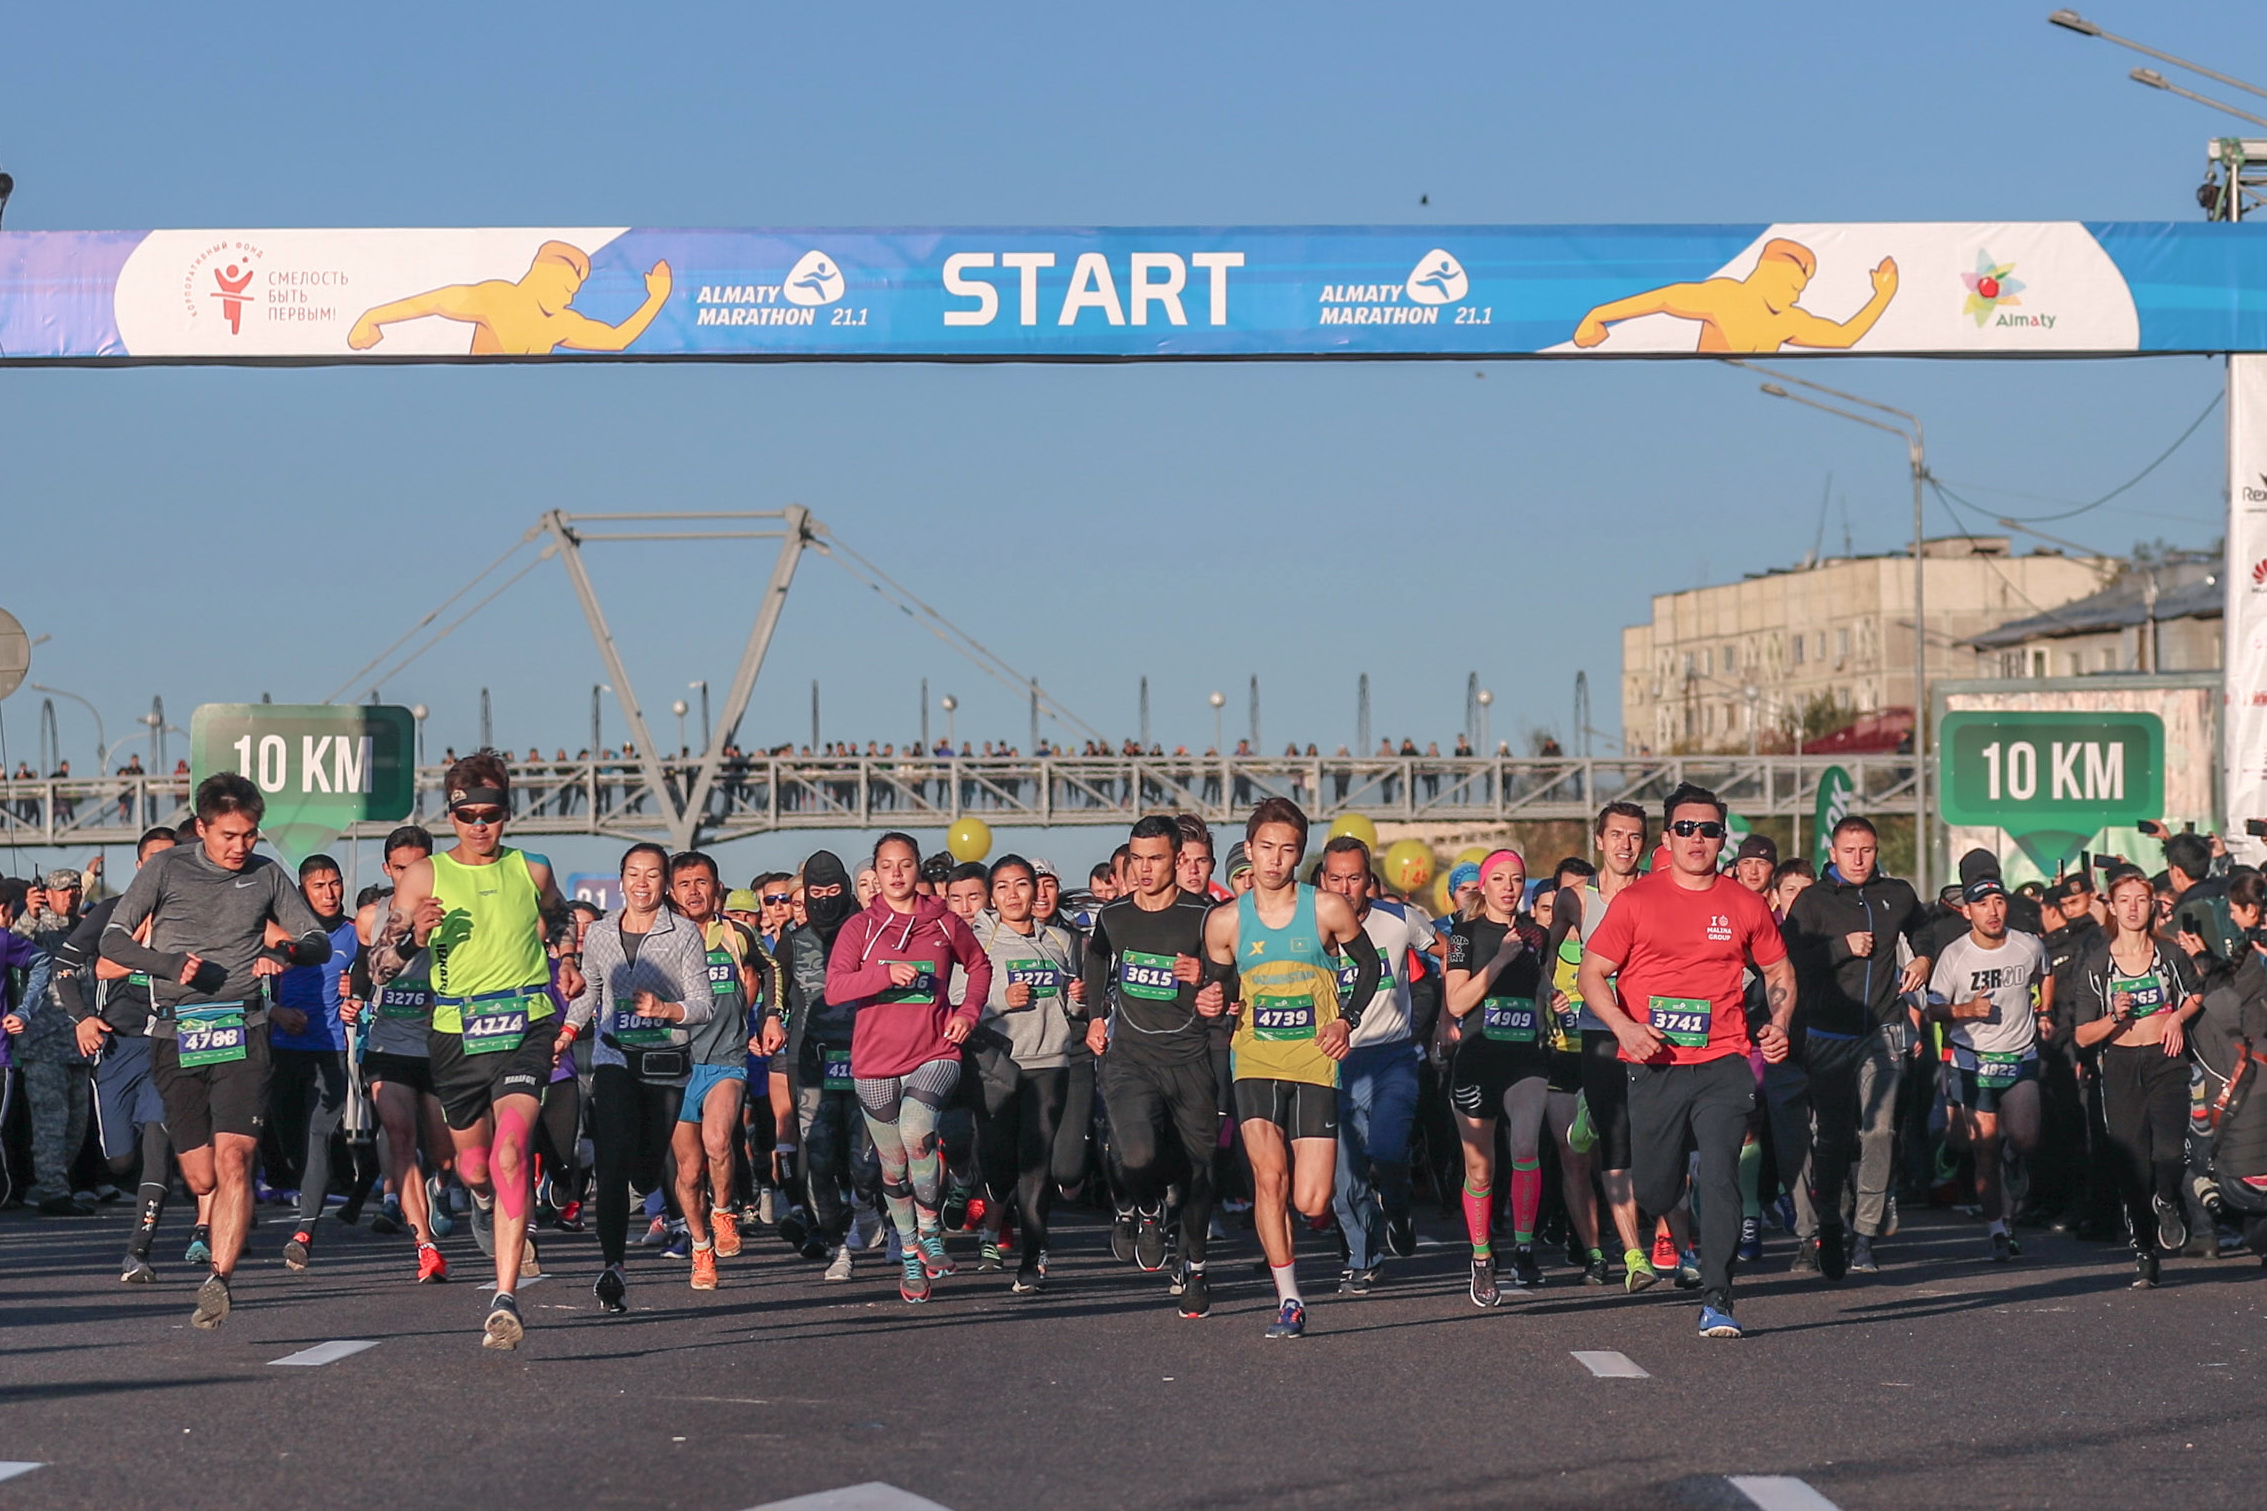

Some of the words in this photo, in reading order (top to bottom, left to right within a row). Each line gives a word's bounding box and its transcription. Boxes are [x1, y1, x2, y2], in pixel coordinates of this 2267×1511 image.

[235, 241, 264, 259] ФОНД
[268, 271, 349, 285] СМЕЛОСТЬ
[268, 289, 308, 303] БЫТЬ
[696, 286, 781, 304] ALMATY
[942, 252, 1245, 326] START
[1319, 285, 1404, 302] ALMATY
[268, 307, 336, 321] ПЕРВЫМ!
[697, 308, 815, 326] MARATHON
[830, 308, 868, 326] 21.1
[1319, 307, 1439, 325] MARATHON
[1454, 307, 1492, 325] 21.1
[1996, 313, 2056, 329] Almaty
[234, 734, 287, 793] 10
[302, 735, 373, 793] KM
[1982, 741, 2037, 800] 10
[2052, 742, 2124, 800] KM
[1014, 972, 1054, 986] 3272
[1126, 967, 1173, 987] 3615
[386, 991, 425, 1006] 3276
[468, 1014, 523, 1036] 4774
[1258, 1010, 1308, 1027] 4739
[1490, 1011, 1531, 1027] 4909
[1654, 1013, 1702, 1032] 3741
[185, 1029, 238, 1050] 4788
[1979, 1063, 2017, 1077] 4822
